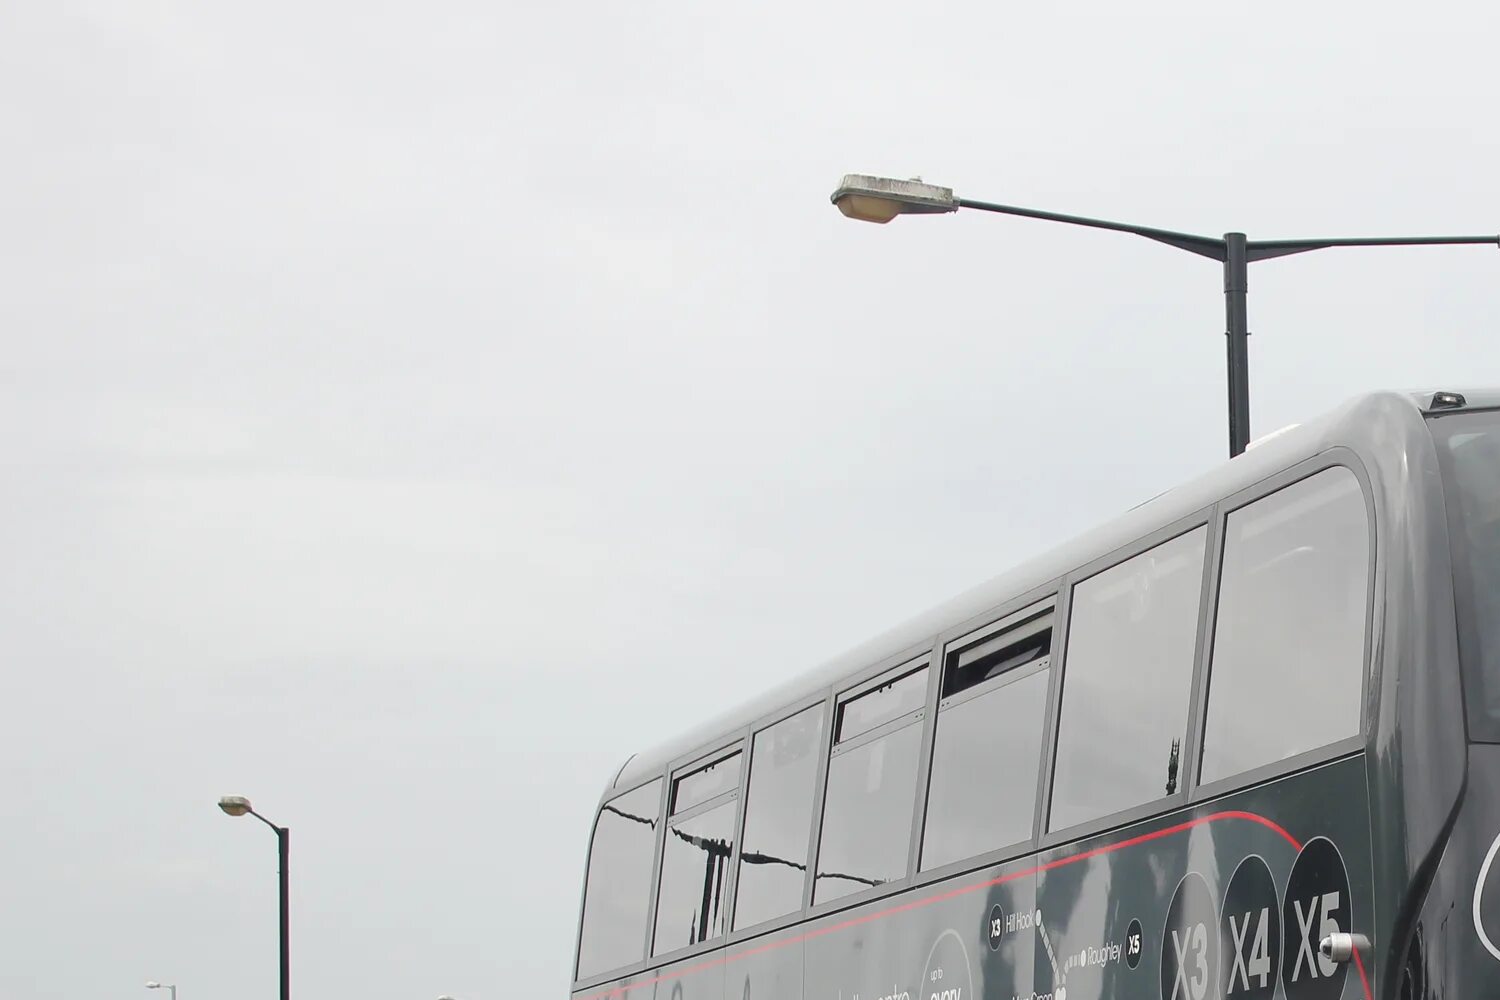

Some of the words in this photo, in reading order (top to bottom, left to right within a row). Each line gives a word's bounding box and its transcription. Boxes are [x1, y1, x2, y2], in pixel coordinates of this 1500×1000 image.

[991, 918, 1001, 938] X3
[1016, 911, 1034, 931] Hook
[1291, 890, 1341, 983] X5
[1087, 941, 1122, 968] Roughley
[1128, 935, 1140, 955] X5
[1227, 907, 1271, 995] X4
[930, 969, 938, 982] up
